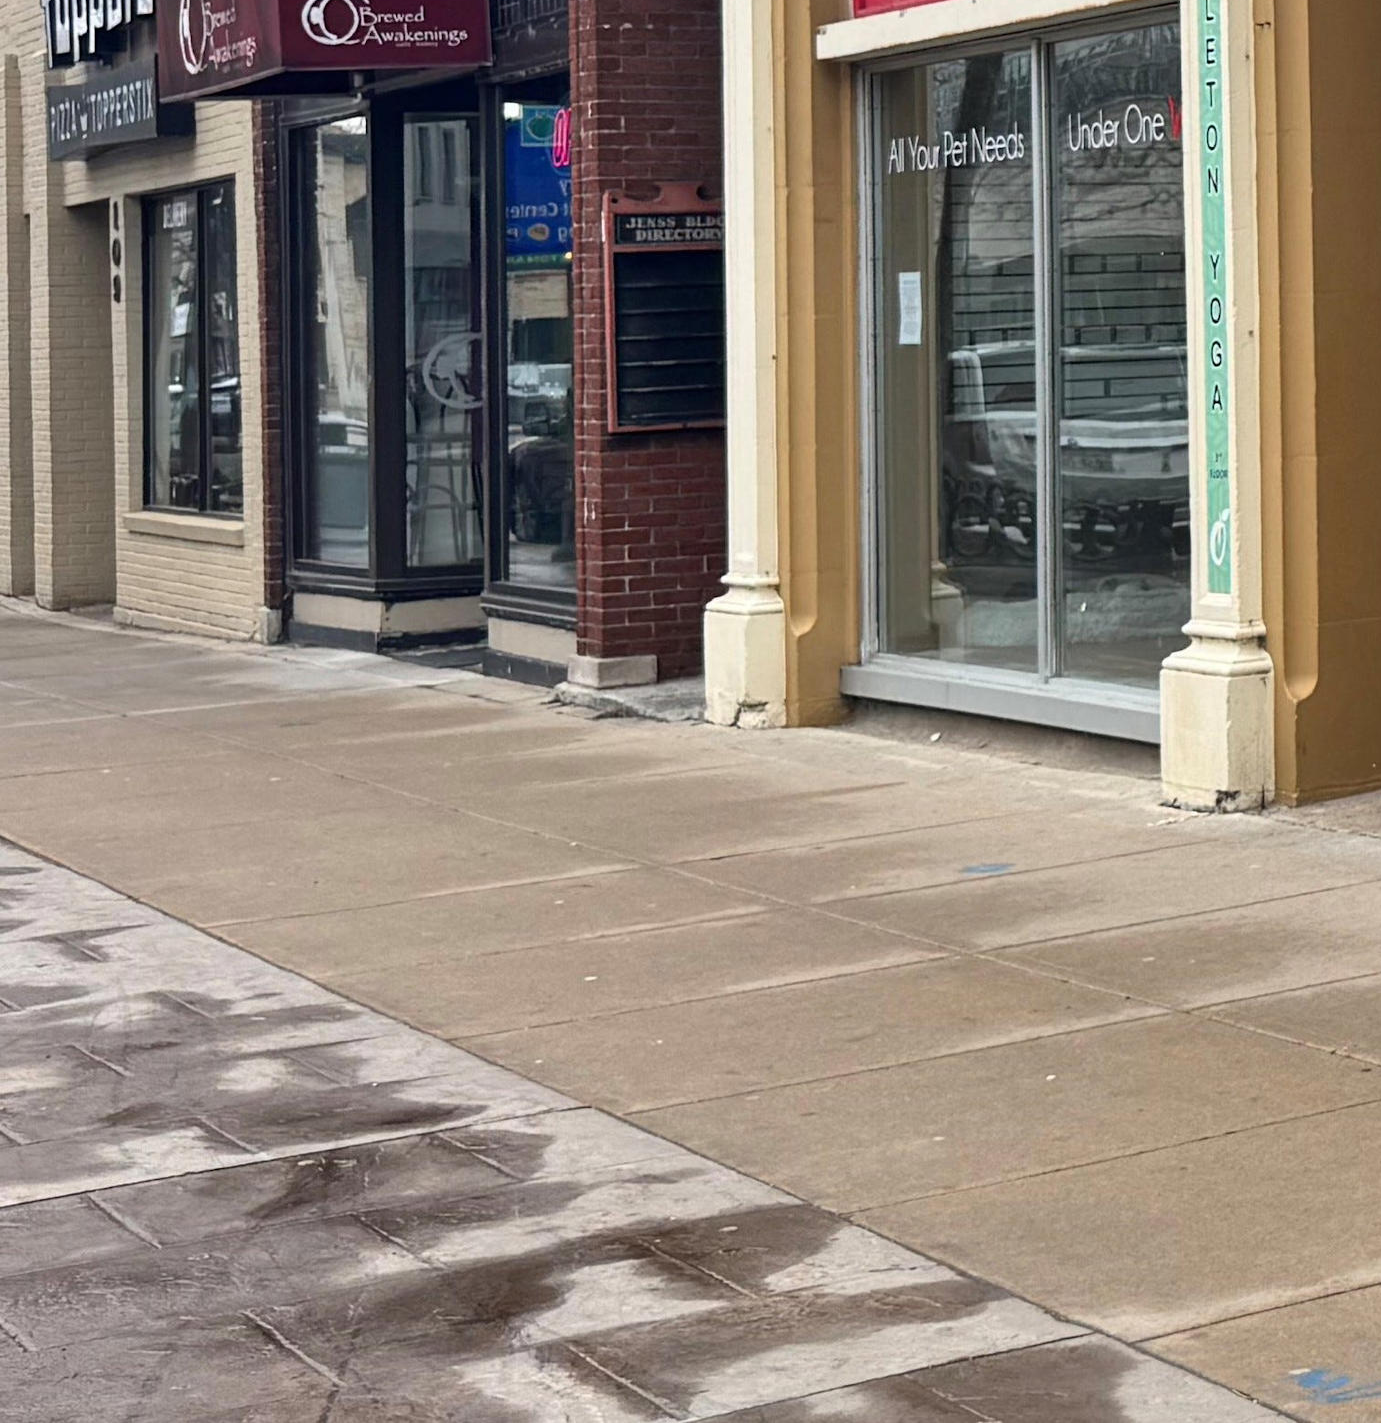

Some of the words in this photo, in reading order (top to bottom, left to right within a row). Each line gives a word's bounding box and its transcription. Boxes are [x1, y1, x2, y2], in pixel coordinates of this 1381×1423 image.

[359, 5, 425, 27] Brewed
[361, 24, 468, 47] Awakenings
[209, 30, 256, 69] Awakenings
[51, 98, 78, 143] PIZZA
[90, 78, 154, 132] TOPPERSTIX
[889, 137, 905, 174] All
[908, 135, 940, 171] Your
[944, 130, 967, 167] Pet
[972, 122, 1025, 163] Needs
[1069, 109, 1119, 152] Under
[1124, 103, 1165, 144] One
[635, 229, 723, 242] DIRECTORY
[1209, 254, 1223, 411] YOGA
